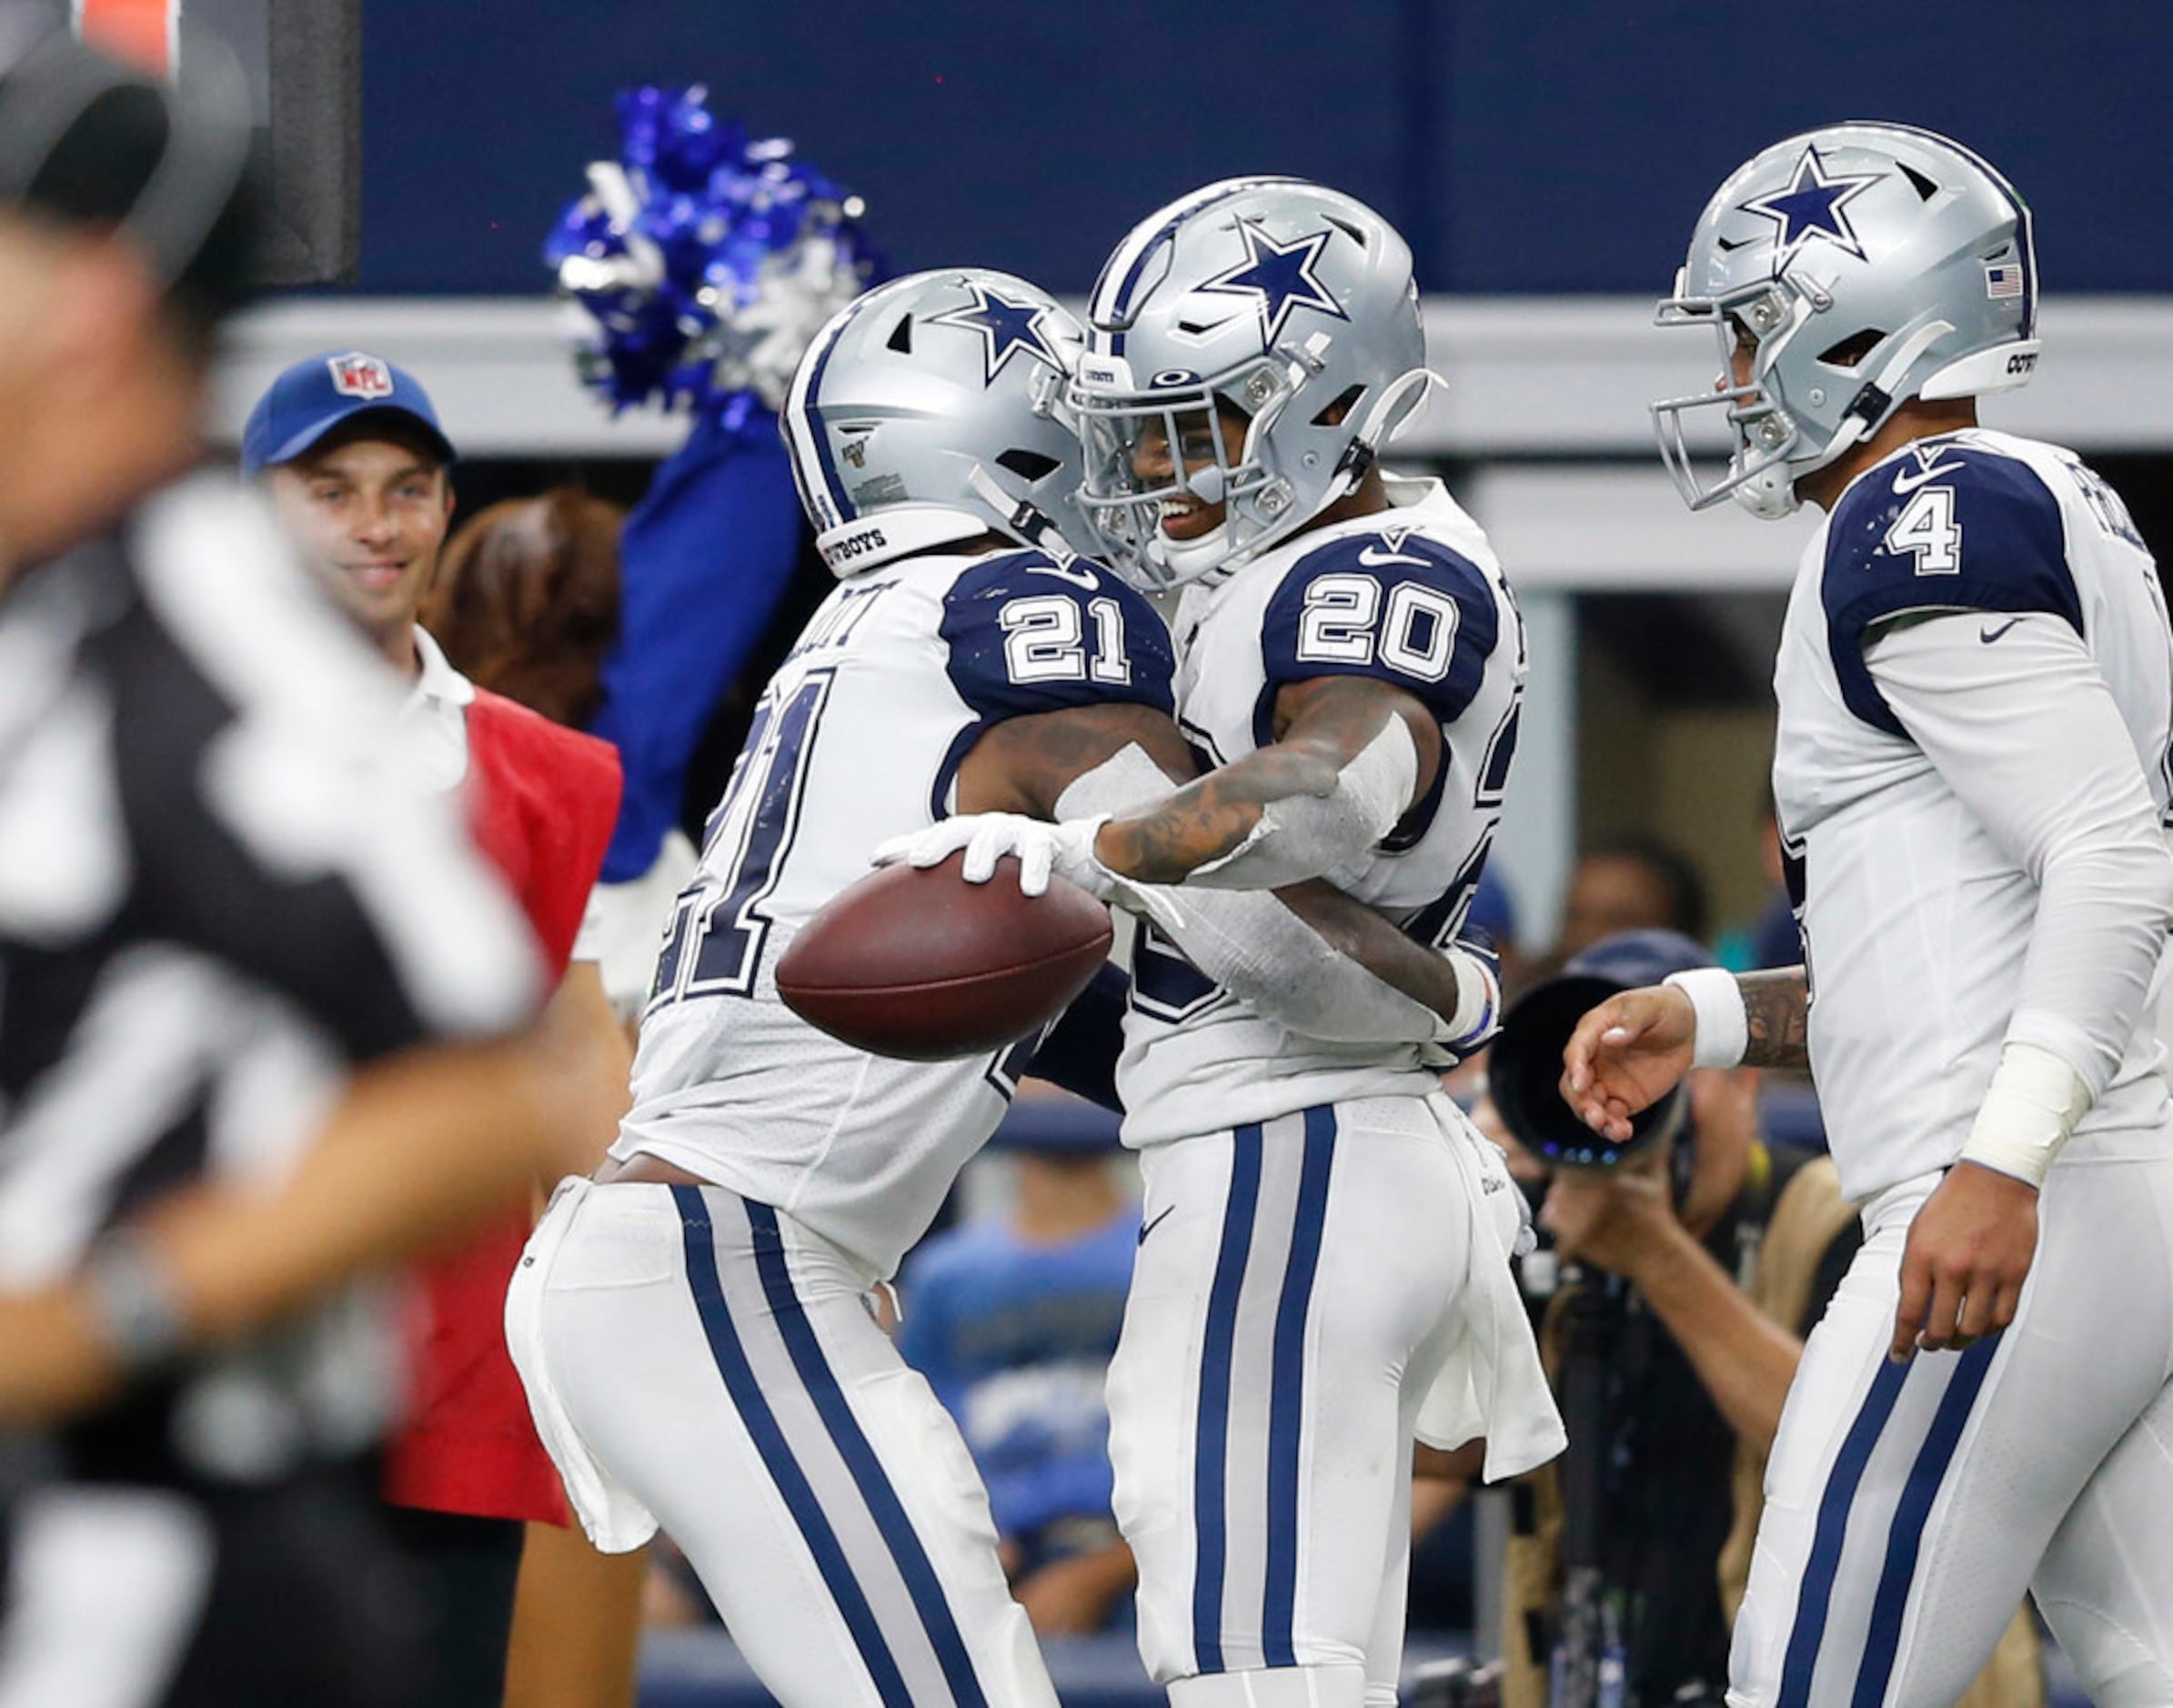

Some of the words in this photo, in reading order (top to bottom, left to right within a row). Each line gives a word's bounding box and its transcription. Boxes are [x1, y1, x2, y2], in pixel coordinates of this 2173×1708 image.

[342, 368, 387, 391] NFL
[1884, 485, 1963, 577] 4
[1000, 594, 1132, 687] 21
[1296, 572, 1460, 684] 20
